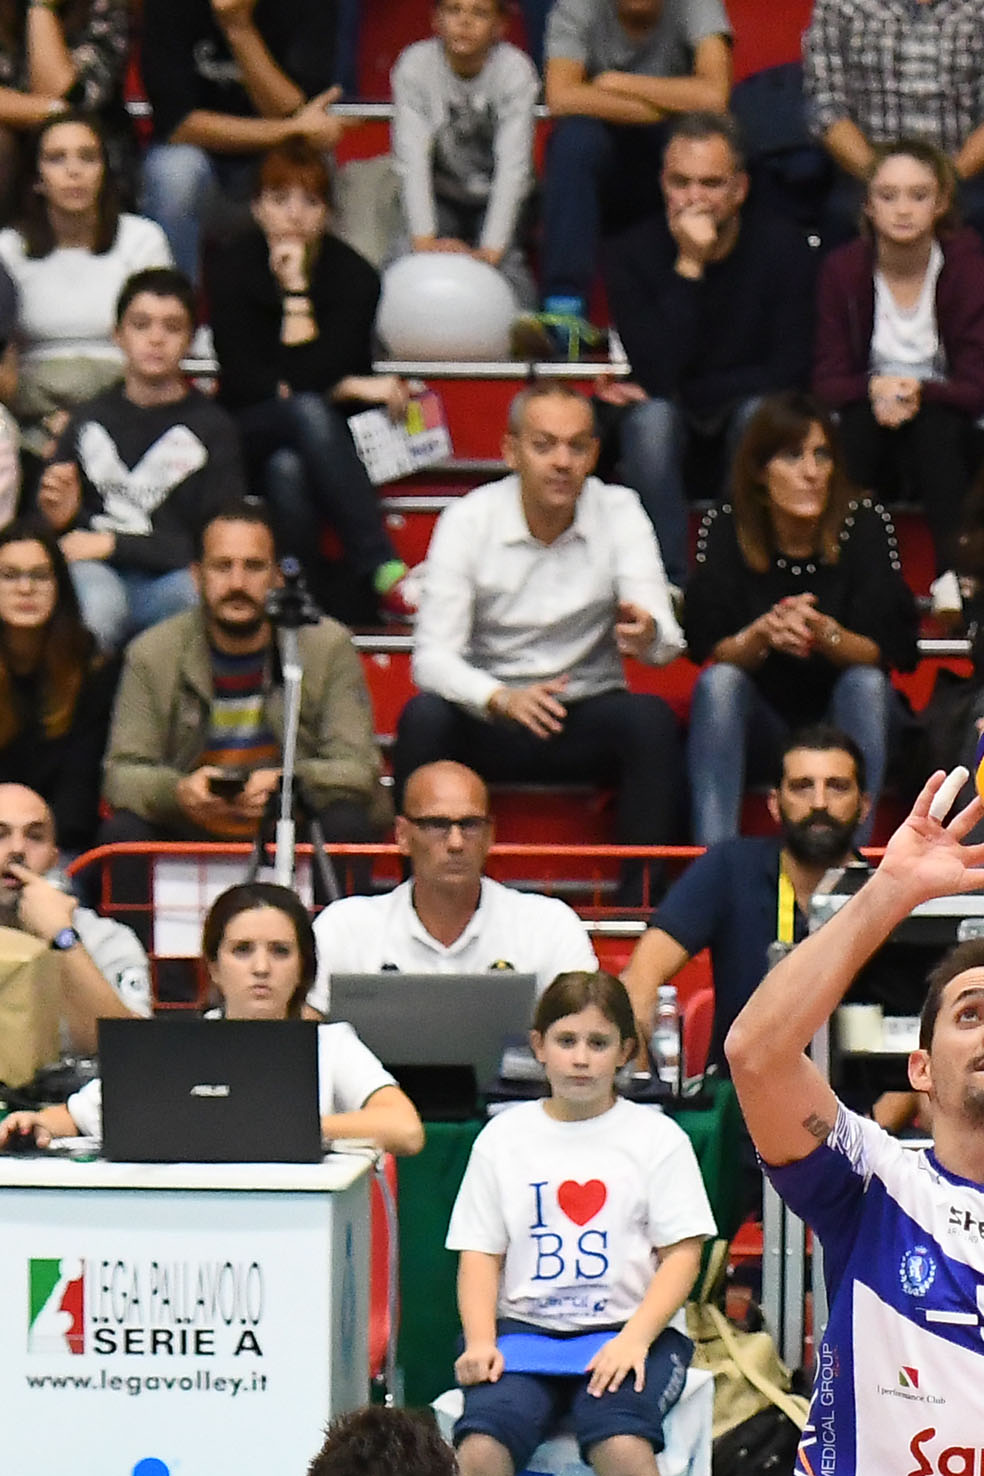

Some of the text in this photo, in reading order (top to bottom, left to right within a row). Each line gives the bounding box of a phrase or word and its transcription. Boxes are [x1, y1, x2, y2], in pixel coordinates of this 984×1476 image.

[530, 1230, 609, 1281] BS
[89, 1259, 263, 1326] LEGA PALLAVOLO
[93, 1328, 263, 1357] SERIE A
[26, 1369, 267, 1397] www.legavolley.it
[820, 1342, 834, 1406] GROUP
